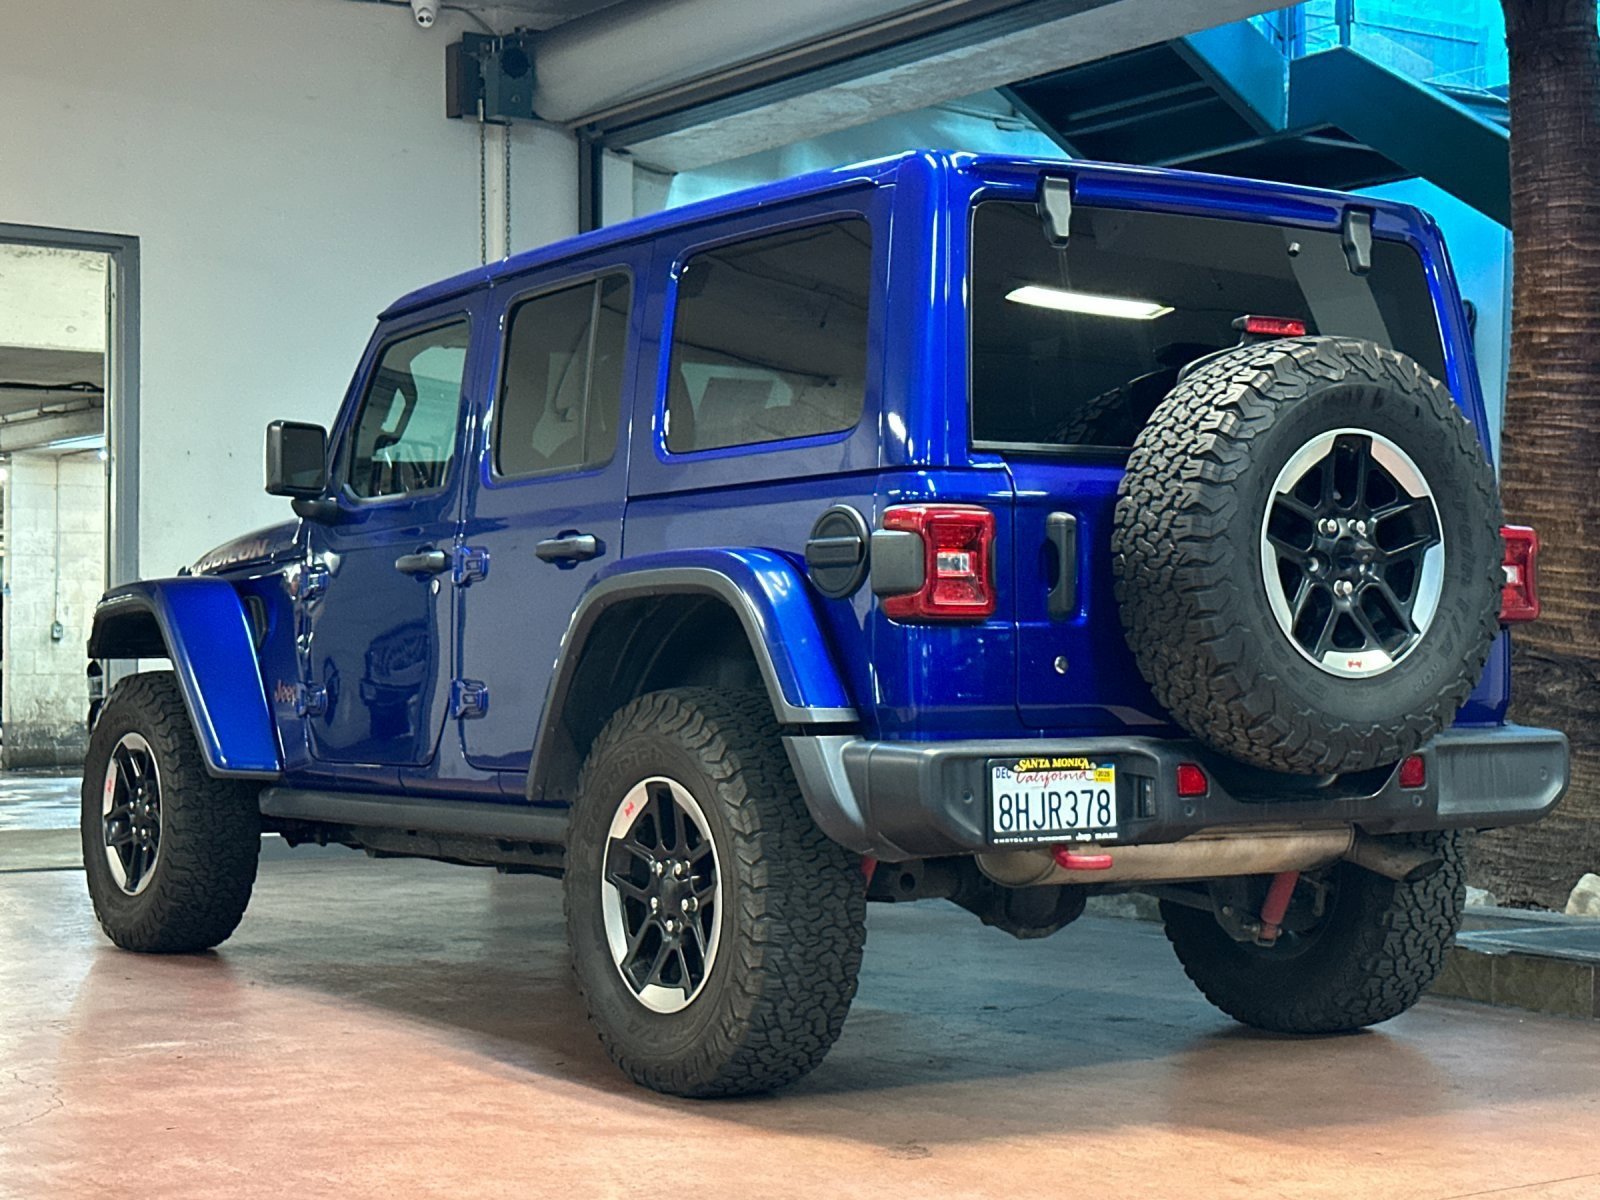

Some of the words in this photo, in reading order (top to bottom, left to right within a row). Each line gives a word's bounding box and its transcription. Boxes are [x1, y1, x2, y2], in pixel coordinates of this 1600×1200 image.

[1018, 759, 1050, 771] SANTA
[1052, 757, 1090, 769] MONICA
[996, 768, 1011, 779] DEC
[1016, 770, 1094, 788] California
[998, 789, 1111, 831] 8HJR378
